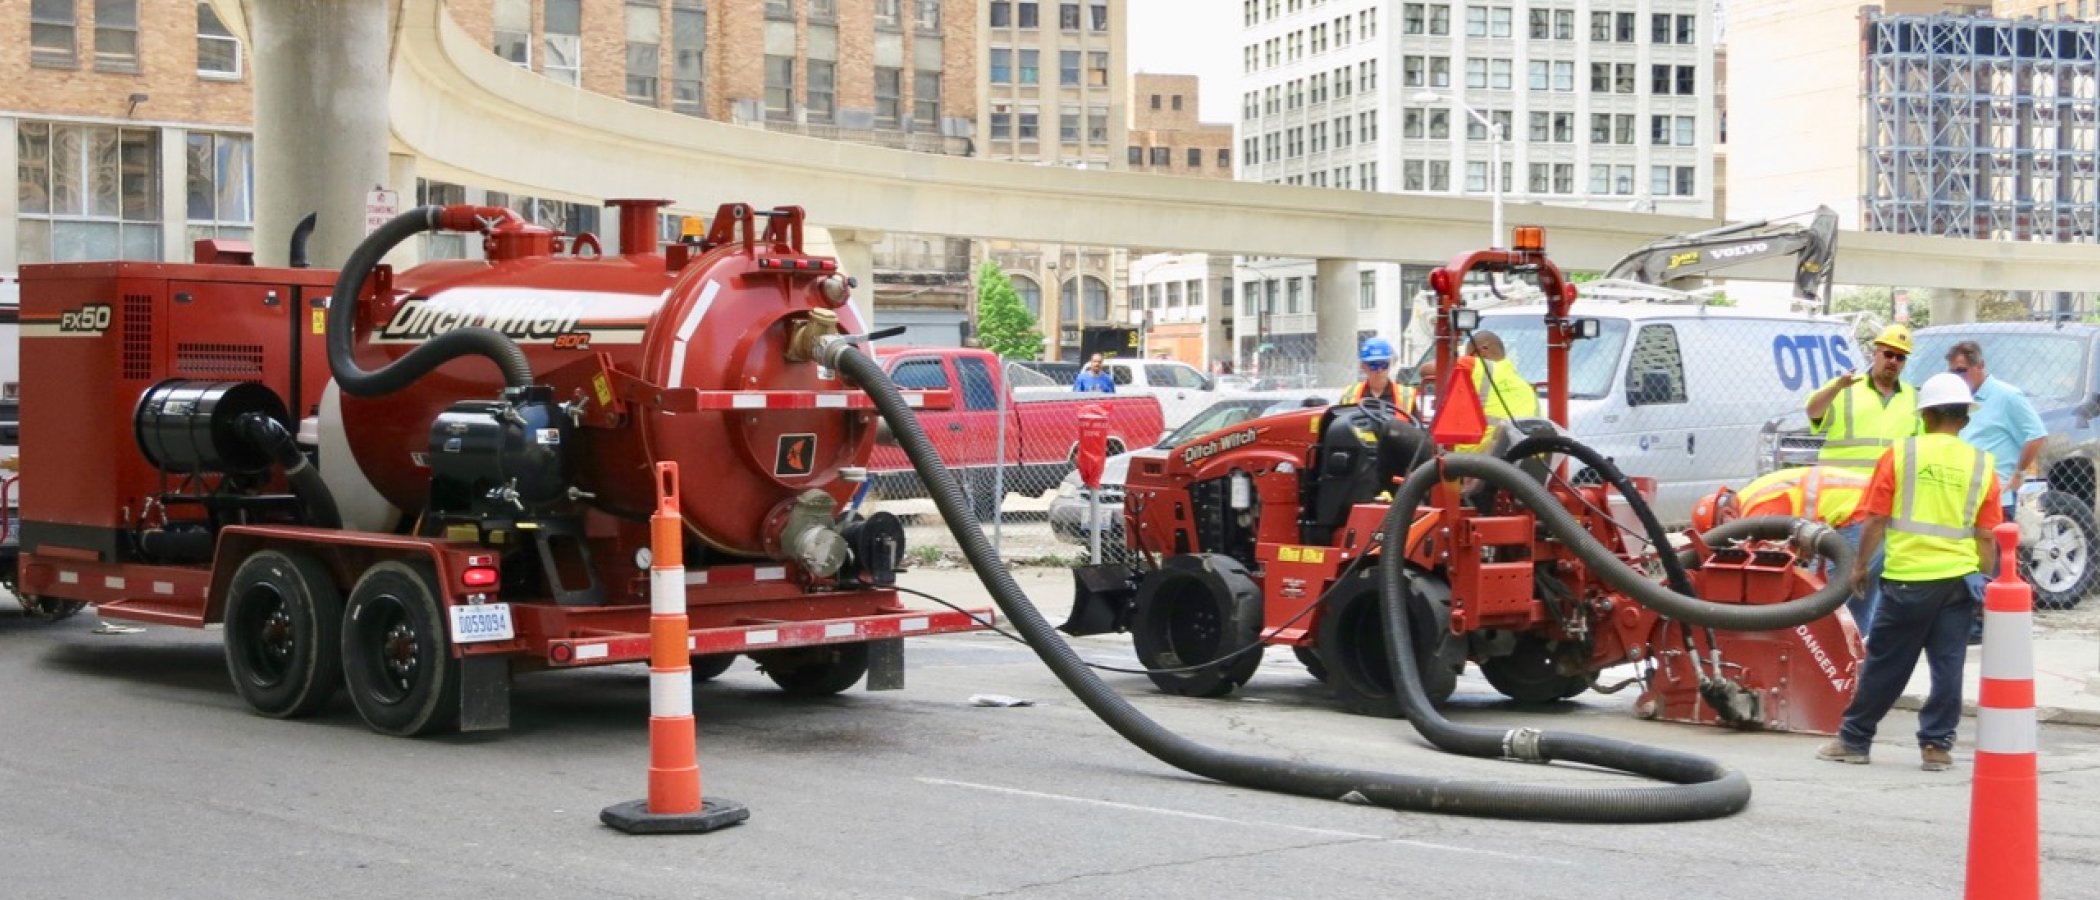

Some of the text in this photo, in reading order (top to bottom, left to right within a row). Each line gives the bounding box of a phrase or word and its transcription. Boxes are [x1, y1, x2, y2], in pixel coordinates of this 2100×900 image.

[1710, 243, 1768, 259] VOLVO
[61, 305, 112, 329] FX50
[386, 299, 581, 333] Ditch Witch
[1773, 334, 1854, 392] OTIS
[1185, 427, 1257, 462] Ditch Witch
[1795, 625, 1837, 679] DANGER
